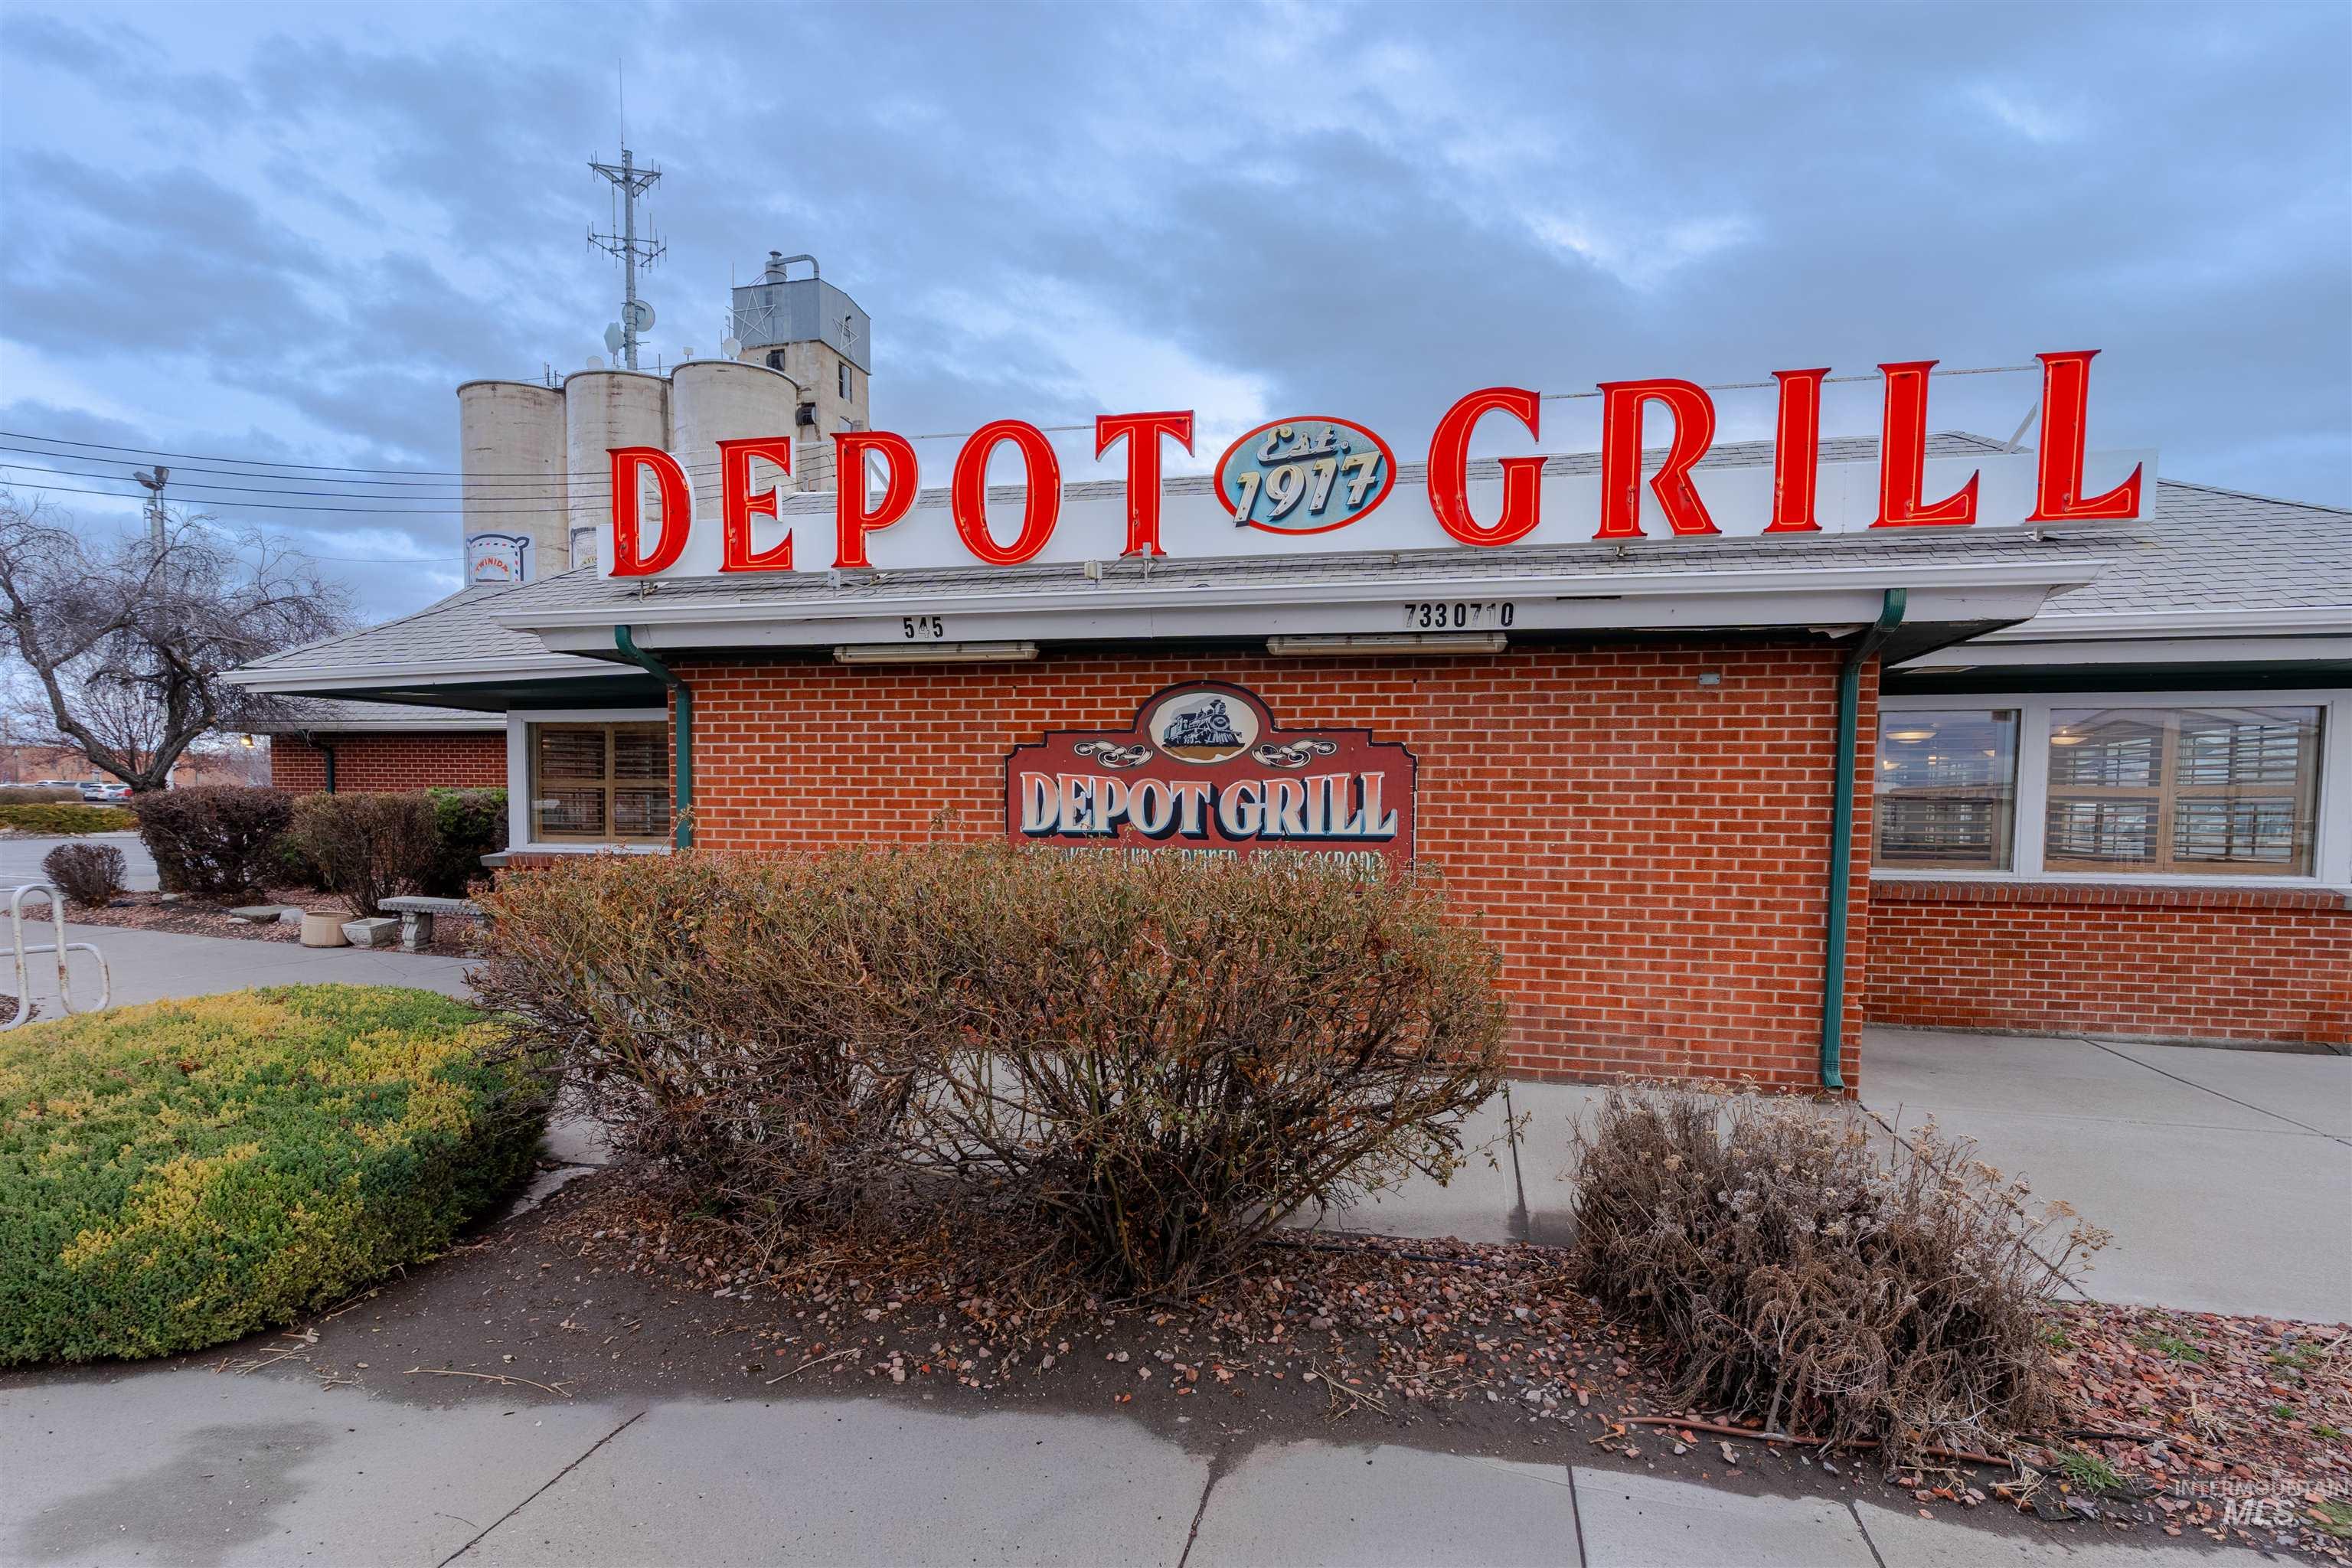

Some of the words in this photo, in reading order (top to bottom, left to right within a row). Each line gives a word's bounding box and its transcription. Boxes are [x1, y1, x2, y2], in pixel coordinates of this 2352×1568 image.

[606, 409, 1195, 576] DEPOT
[1428, 349, 2141, 547] GRILL
[1020, 771, 1212, 835] DEPOT
[1219, 771, 1398, 837] GRILL
